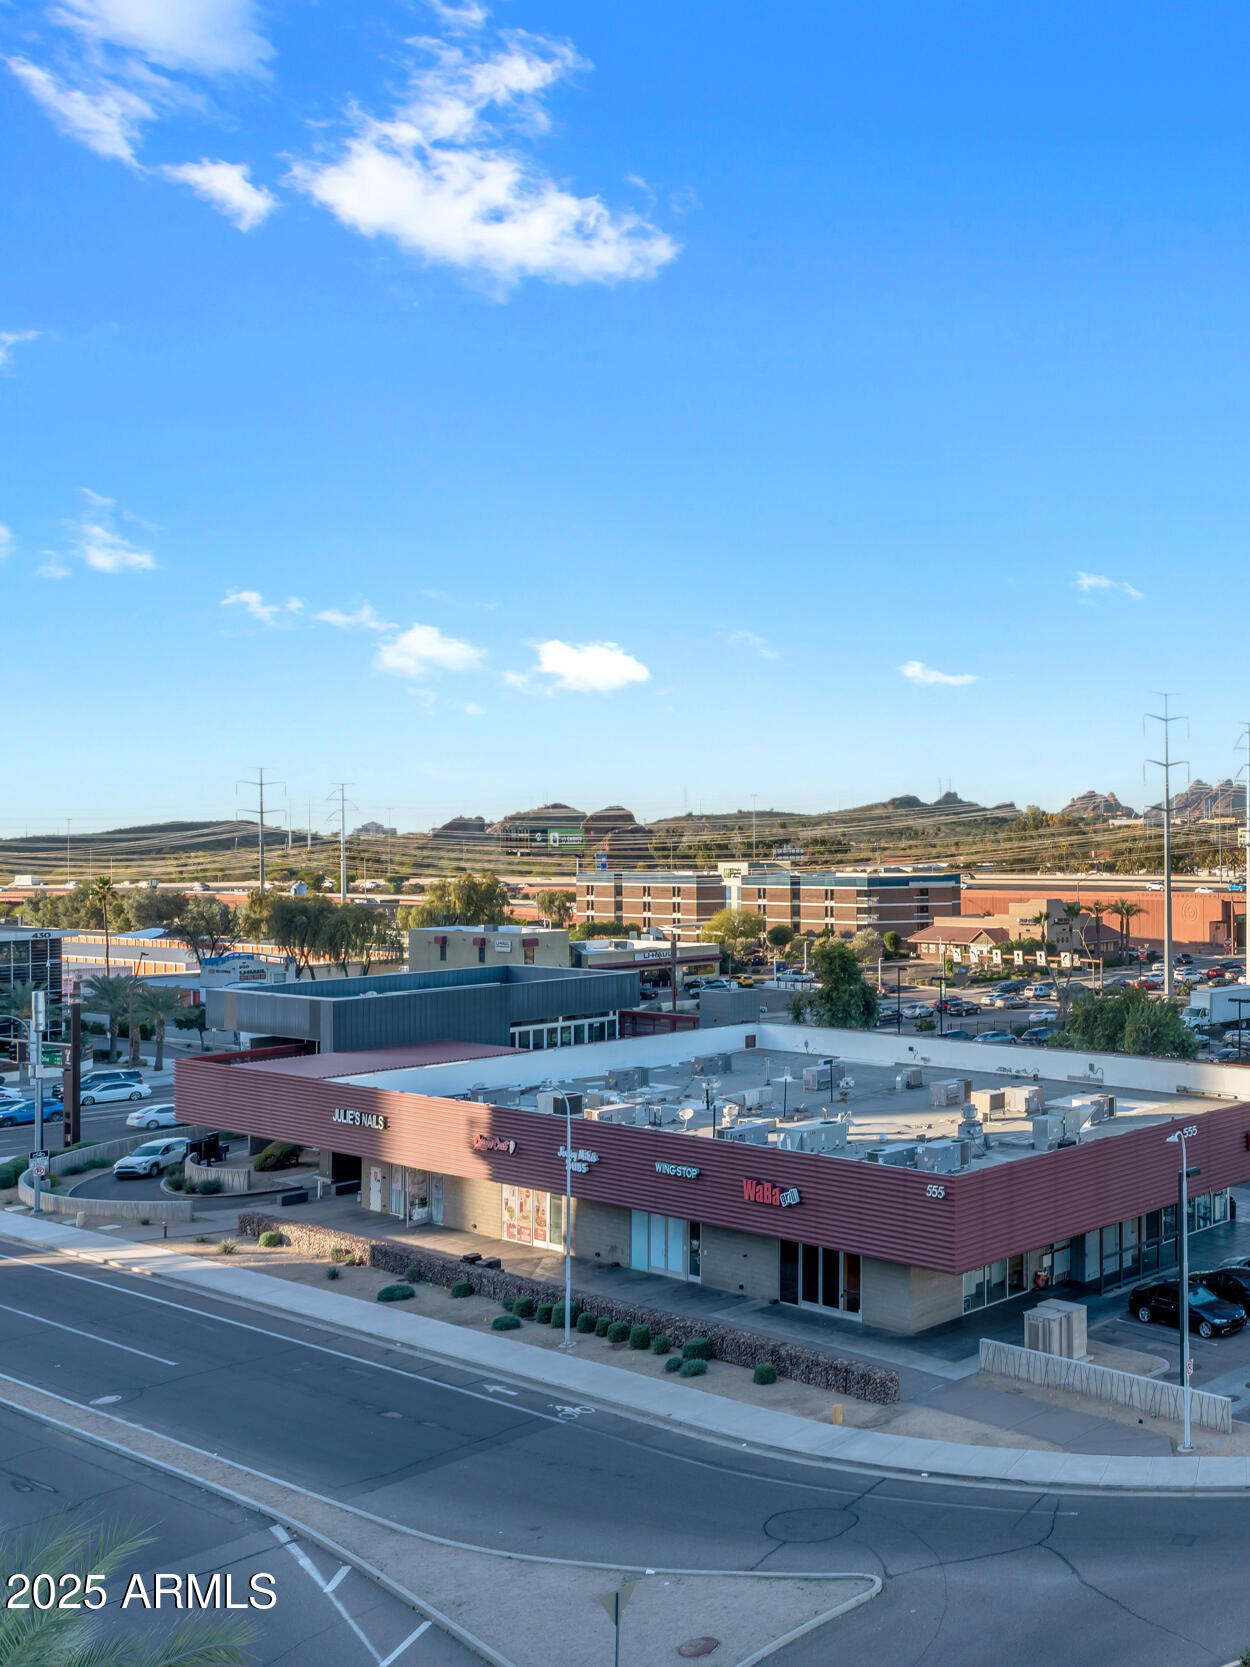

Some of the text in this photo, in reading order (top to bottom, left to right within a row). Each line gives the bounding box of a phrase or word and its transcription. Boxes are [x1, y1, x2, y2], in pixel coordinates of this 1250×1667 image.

[332, 1108, 385, 1130] JULIE'S NAILS
[1183, 1125, 1198, 1138] 555
[557, 1145, 578, 1162] Jeey
[743, 1178, 800, 1207] WaBa grill
[926, 1184, 946, 1199] 555
